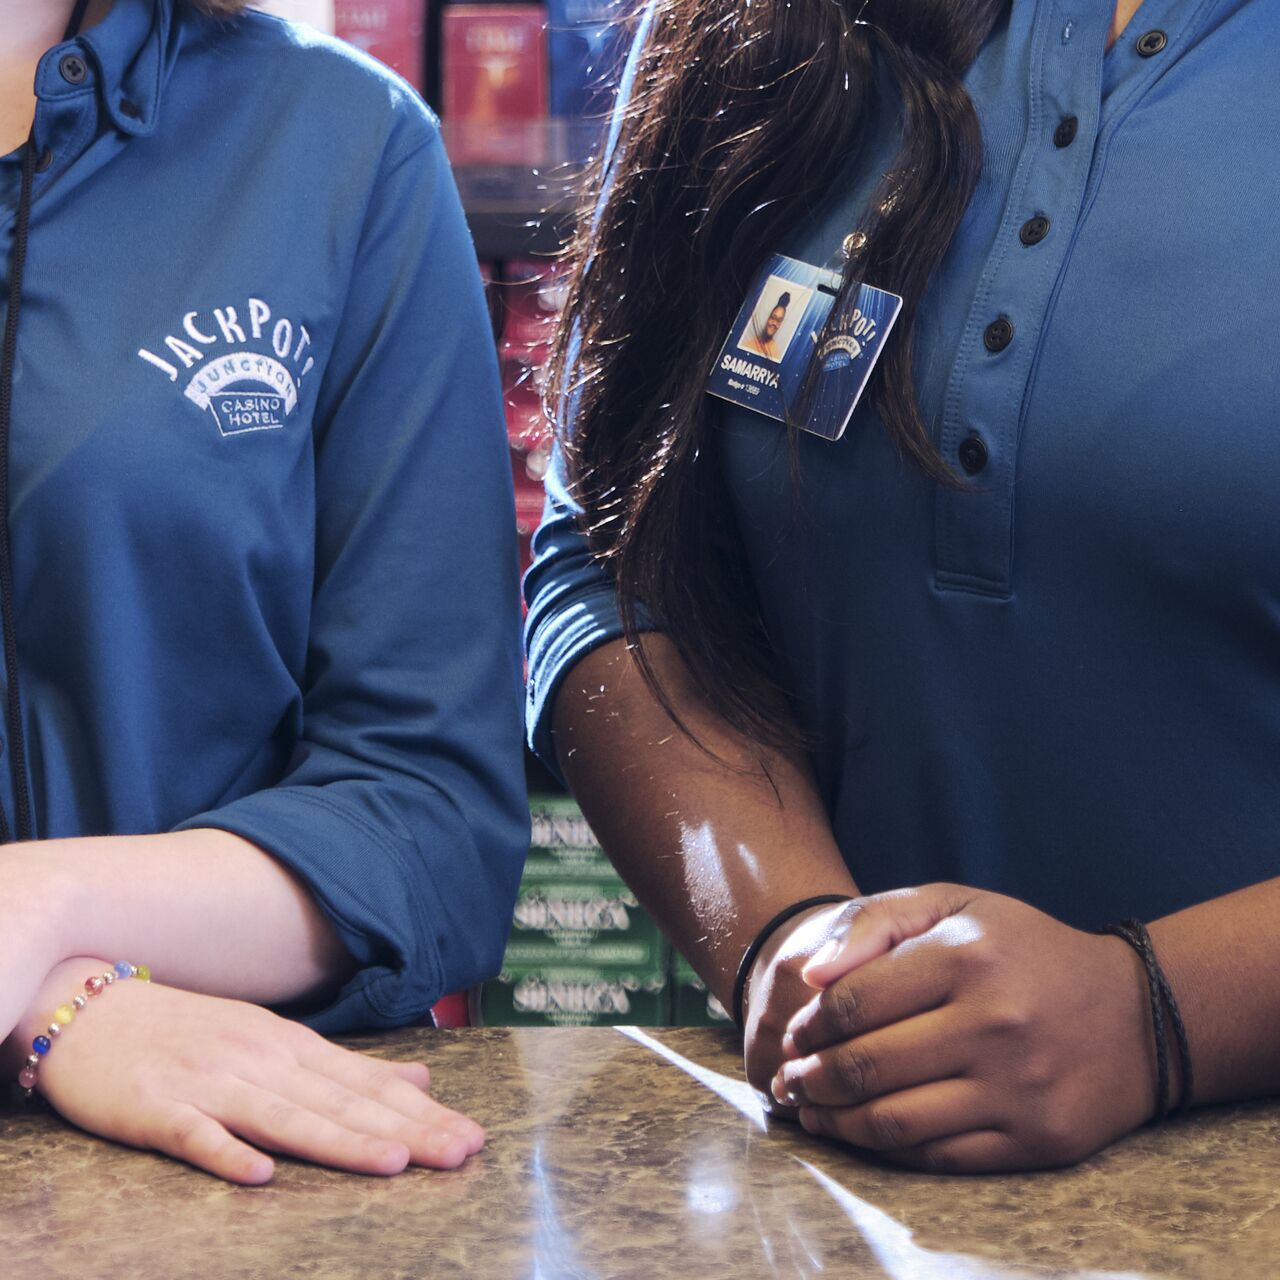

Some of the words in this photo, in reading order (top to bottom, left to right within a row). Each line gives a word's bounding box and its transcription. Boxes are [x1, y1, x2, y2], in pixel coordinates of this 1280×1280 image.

[137, 297, 315, 388] JACKPOT!
[198, 357, 293, 398] JUNCTION
[720, 354, 780, 389] SAMARRYA
[220, 398, 281, 414] CASINO
[228, 411, 280, 426] HOTEL
